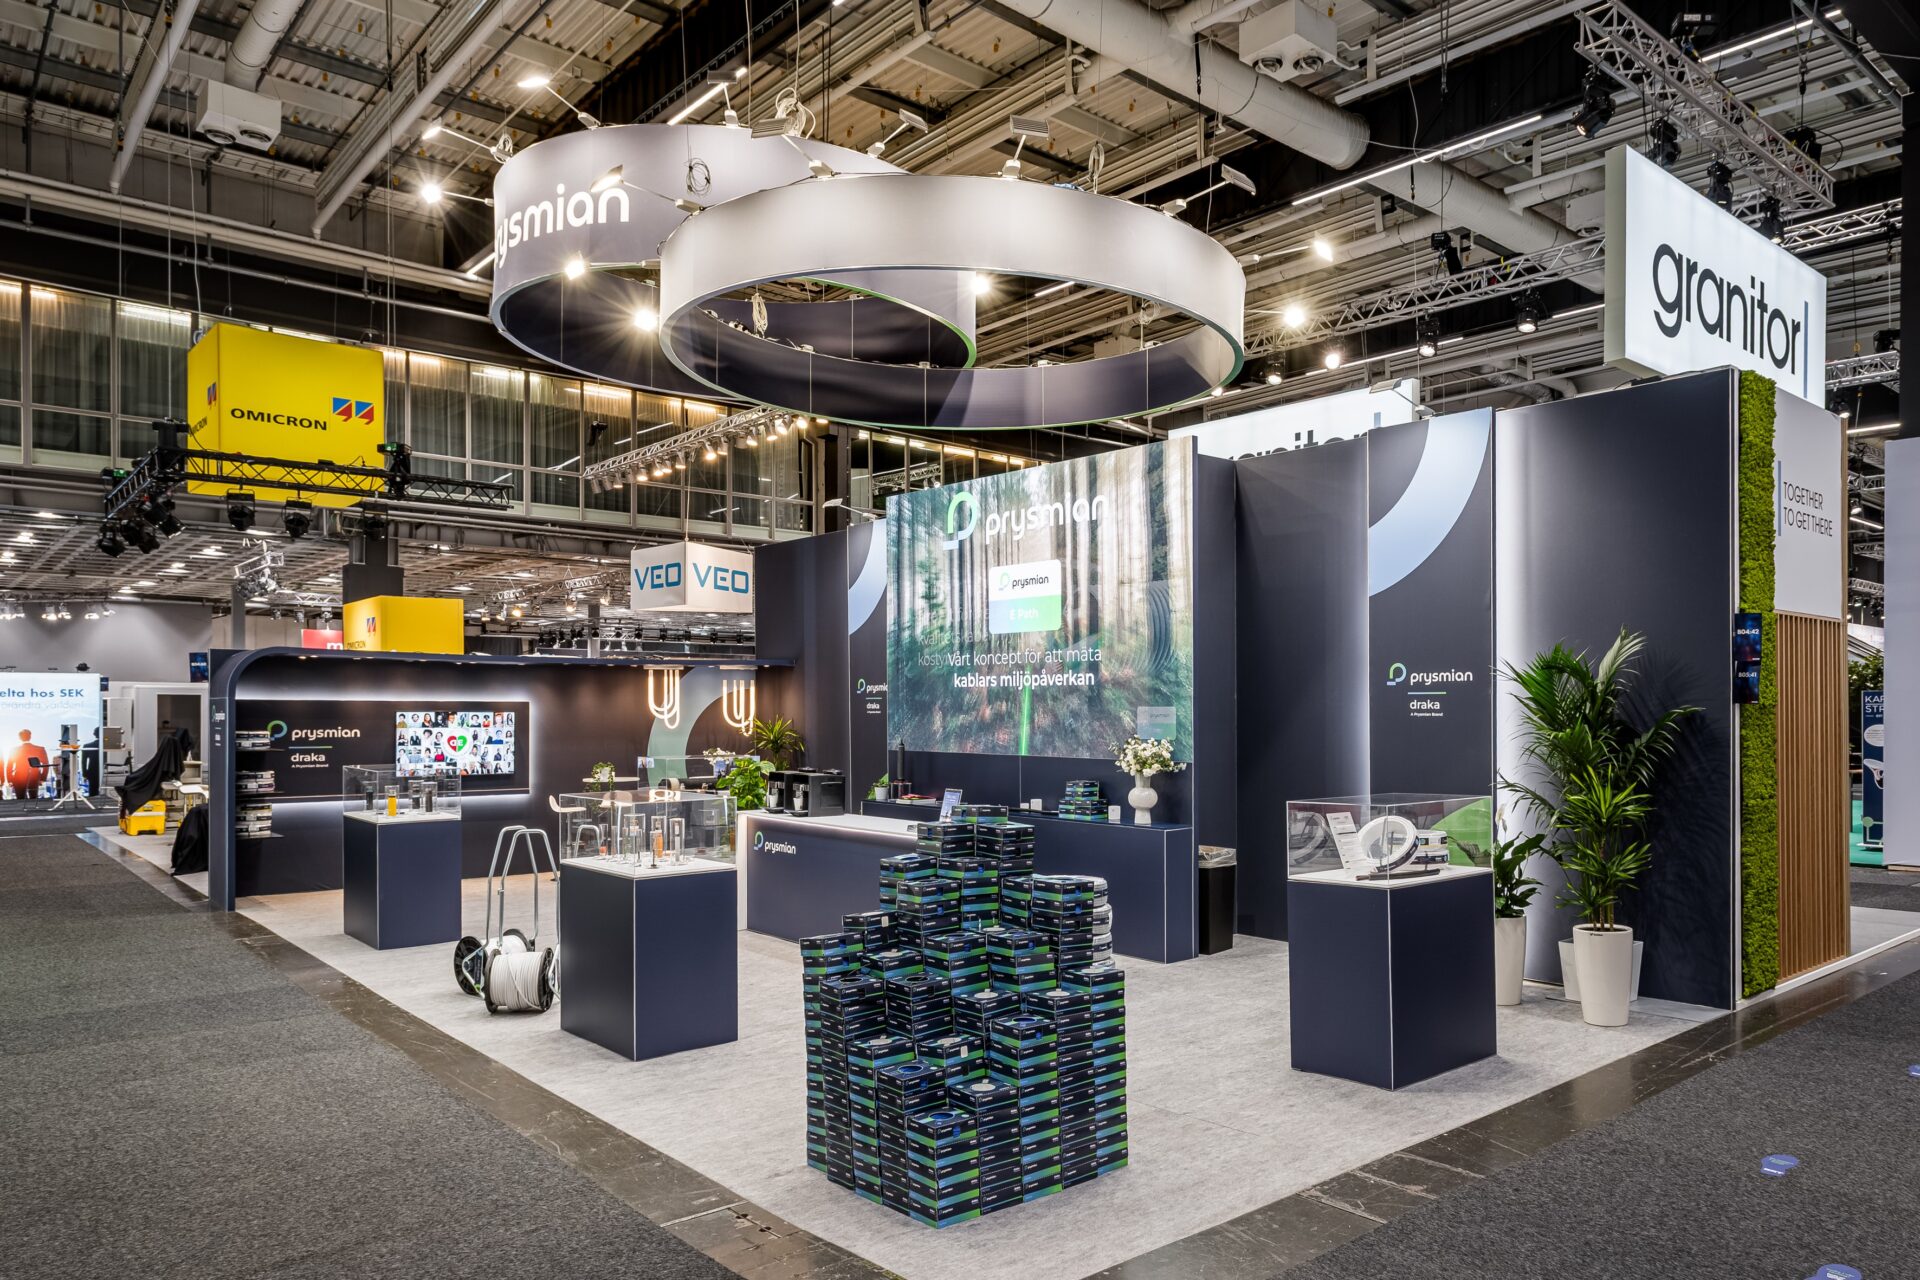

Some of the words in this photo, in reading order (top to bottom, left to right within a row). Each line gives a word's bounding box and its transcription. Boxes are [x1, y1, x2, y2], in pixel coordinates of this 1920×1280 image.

[1653, 243, 1801, 375] granitor
[230, 408, 327, 431] OMICRON
[1783, 481, 1824, 510] TOGETHER
[985, 491, 1110, 545] prysmian
[1783, 507, 1795, 526] TO
[1795, 510, 1810, 531] GET
[1811, 515, 1833, 537] THERE
[634, 562, 681, 591] VEO
[692, 562, 749, 594] VEO
[1012, 574, 1049, 590] prysmian
[948, 650, 970, 667] Vårt
[973, 650, 1022, 668] koncept
[1024, 649, 1042, 664] för
[1045, 649, 1062, 663] att
[1066, 647, 1102, 662] mäta
[954, 673, 997, 688] kablars
[1000, 669, 1095, 691] miljöpåverkan
[1410, 668, 1473, 686] prysmian
[30, 688, 55, 697] hos
[60, 688, 84, 697] SEK
[1409, 699, 1440, 710] draka
[291, 726, 361, 741] prysmian
[291, 753, 326, 762] draka
[764, 841, 796, 855] prysmian
